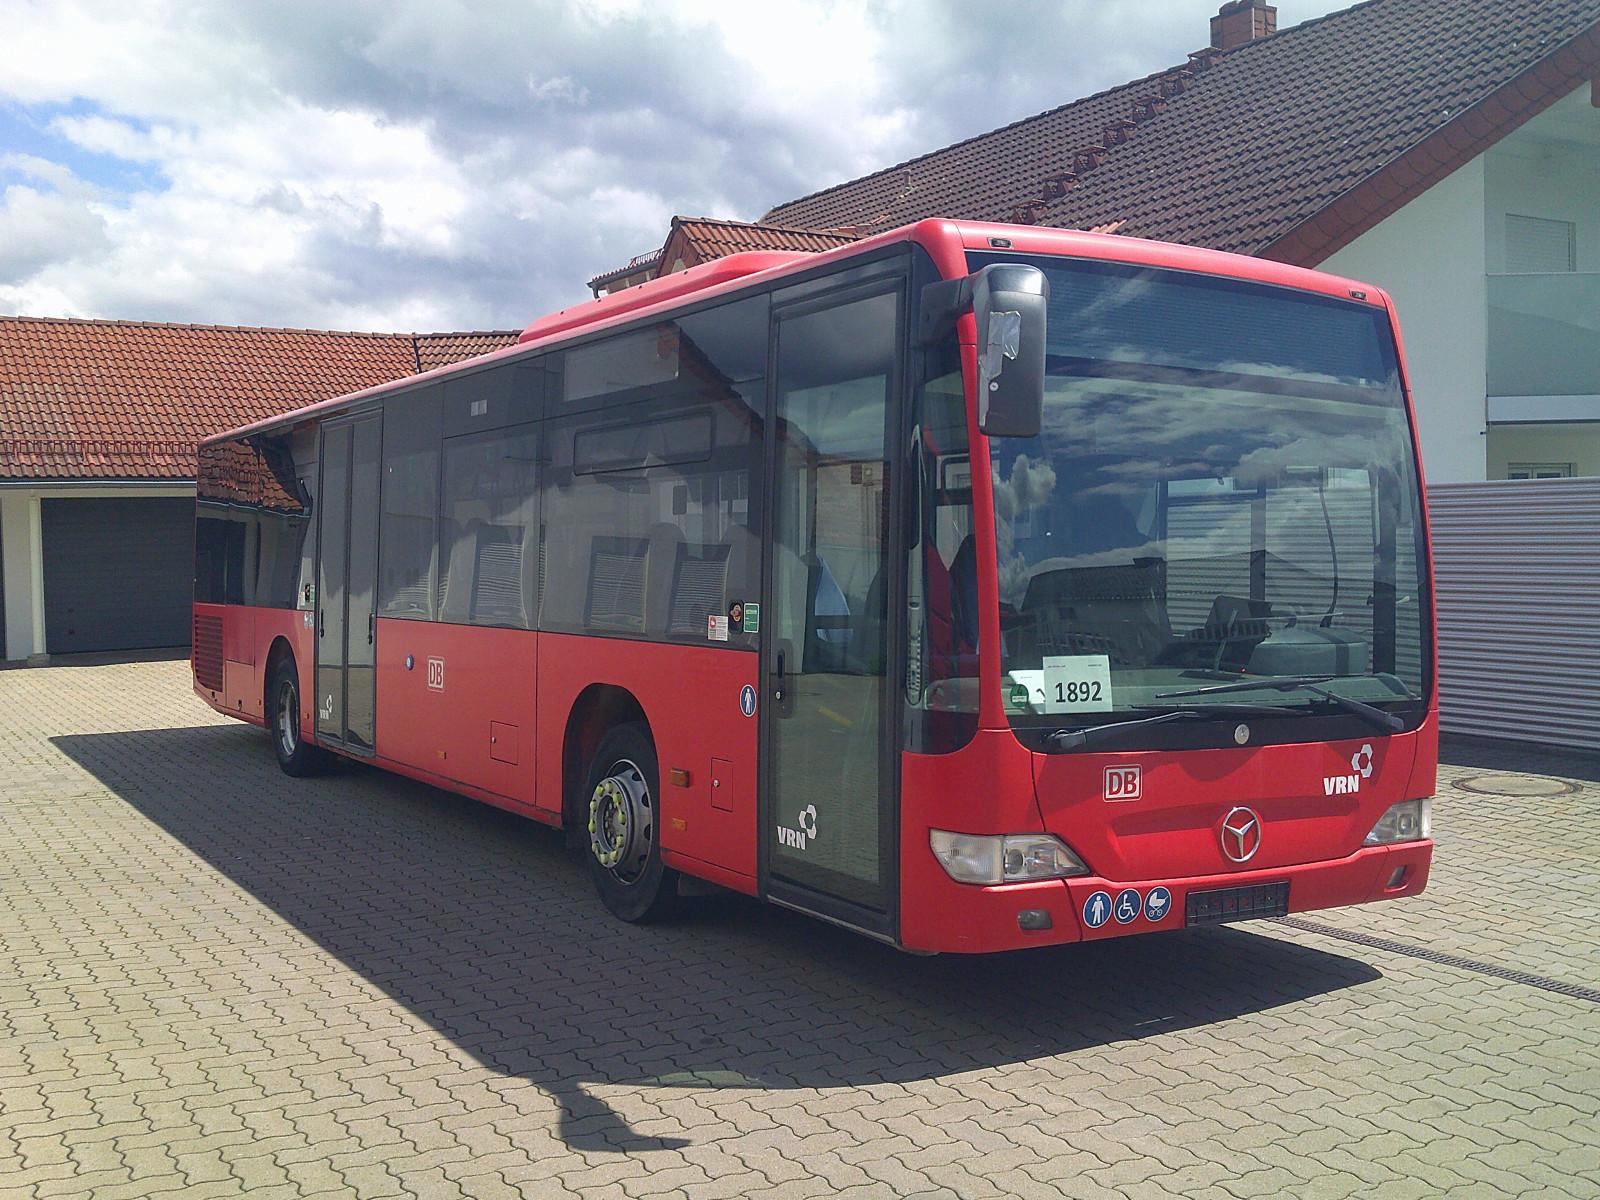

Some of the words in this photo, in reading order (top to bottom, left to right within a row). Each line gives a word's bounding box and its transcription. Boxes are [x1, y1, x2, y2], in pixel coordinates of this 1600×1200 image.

[428, 661, 444, 686] DB
[1055, 681, 1102, 703] 1892
[1107, 769, 1140, 798] DB
[1323, 775, 1359, 796] VRN
[777, 826, 806, 850] VRN
